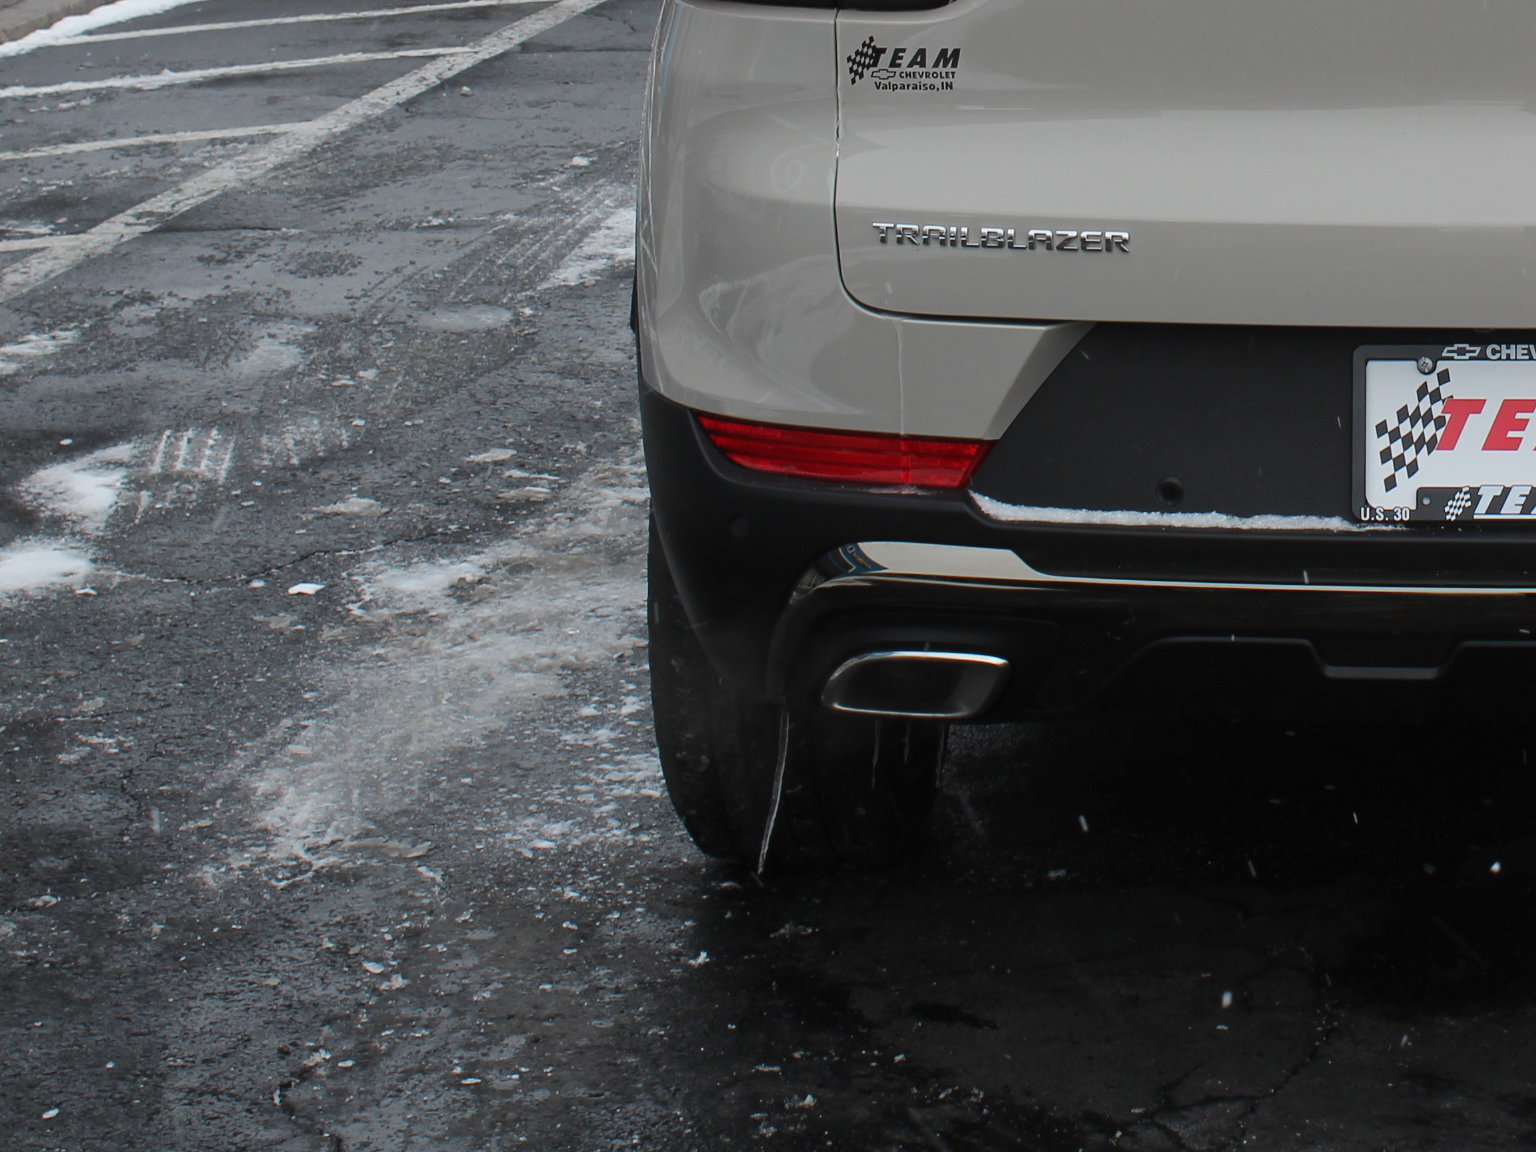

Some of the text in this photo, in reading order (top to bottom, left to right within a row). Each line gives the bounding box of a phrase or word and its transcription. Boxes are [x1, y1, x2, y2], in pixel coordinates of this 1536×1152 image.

[870, 48, 961, 68] TEAM
[899, 71, 956, 79] CHEVROLET
[872, 222, 1131, 253] TRAILBLAZER
[1360, 507, 1410, 521] U.S. 30
